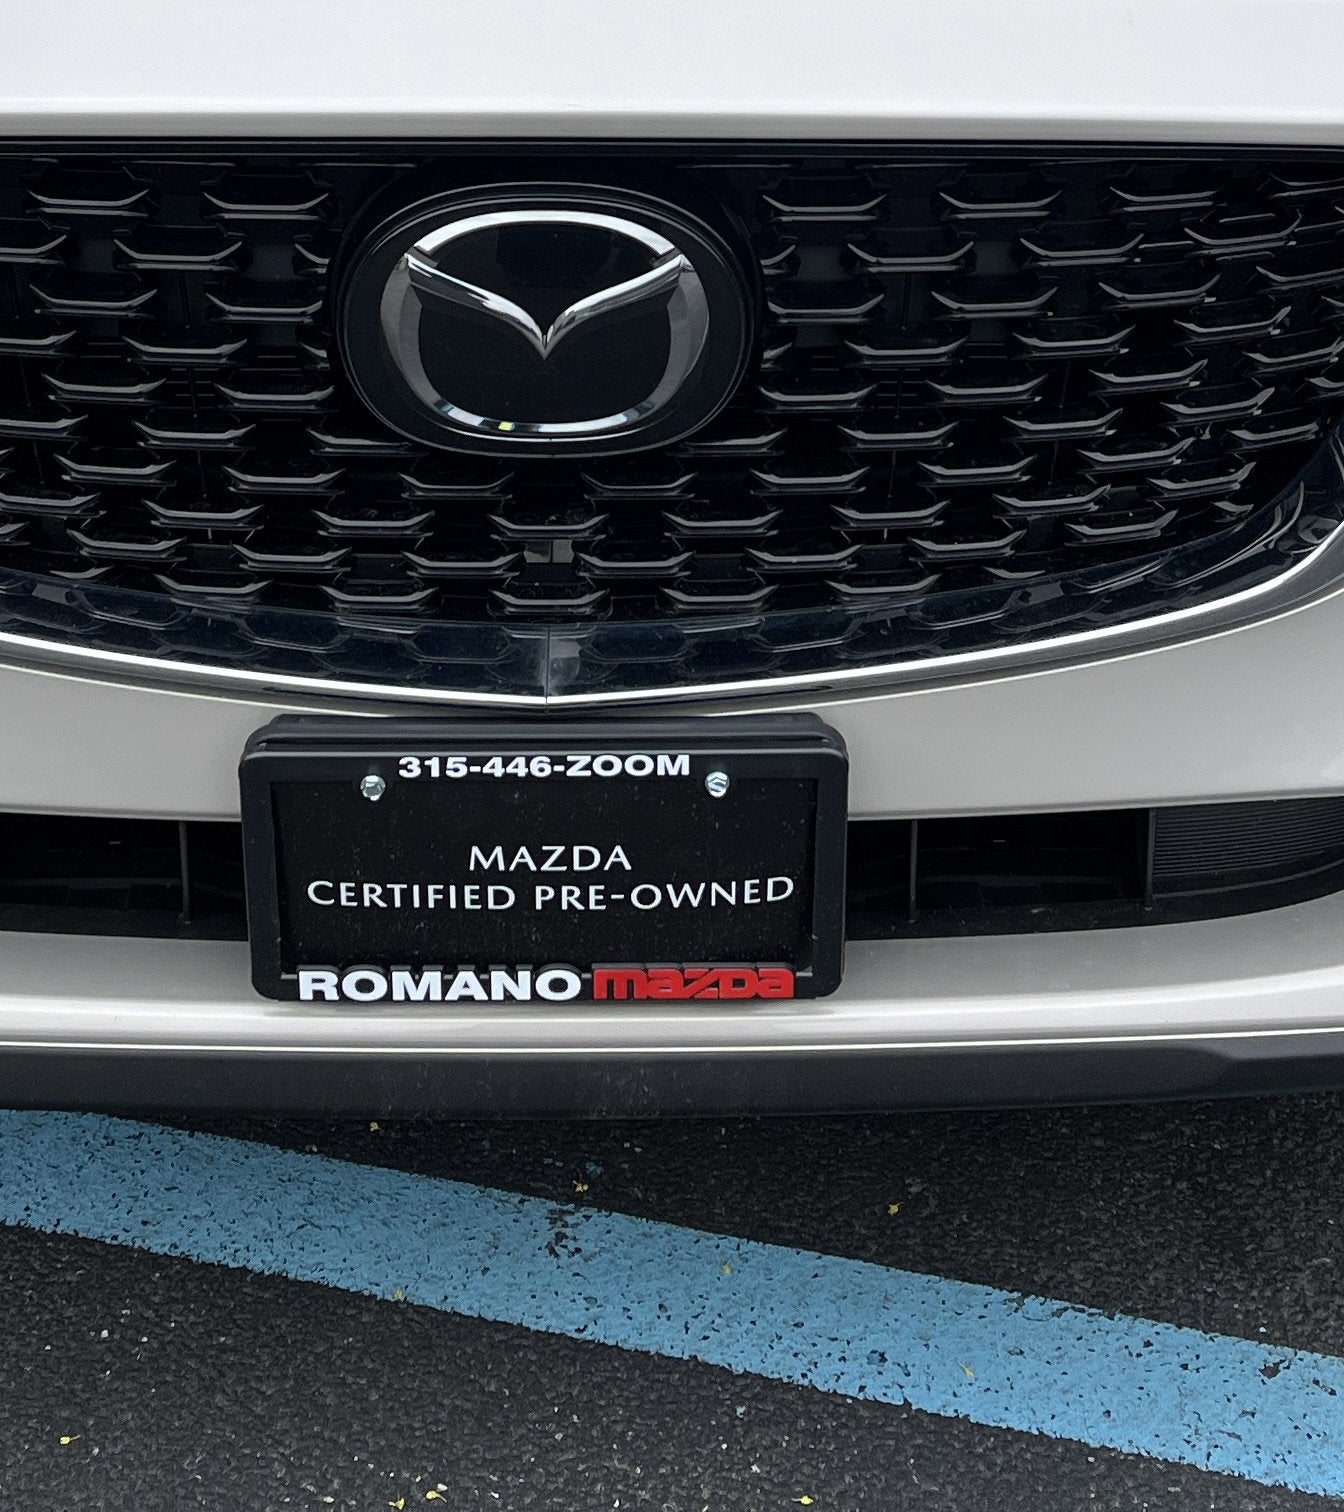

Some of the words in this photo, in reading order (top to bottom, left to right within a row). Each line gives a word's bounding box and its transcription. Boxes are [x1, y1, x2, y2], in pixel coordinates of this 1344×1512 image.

[398, 755, 690, 778] 315-446-ZOOM
[469, 845, 632, 872] MAZDA
[307, 880, 516, 910] CERTIFIED
[535, 876, 794, 911] PRE-OWNED
[298, 969, 581, 1002] ROMANO
